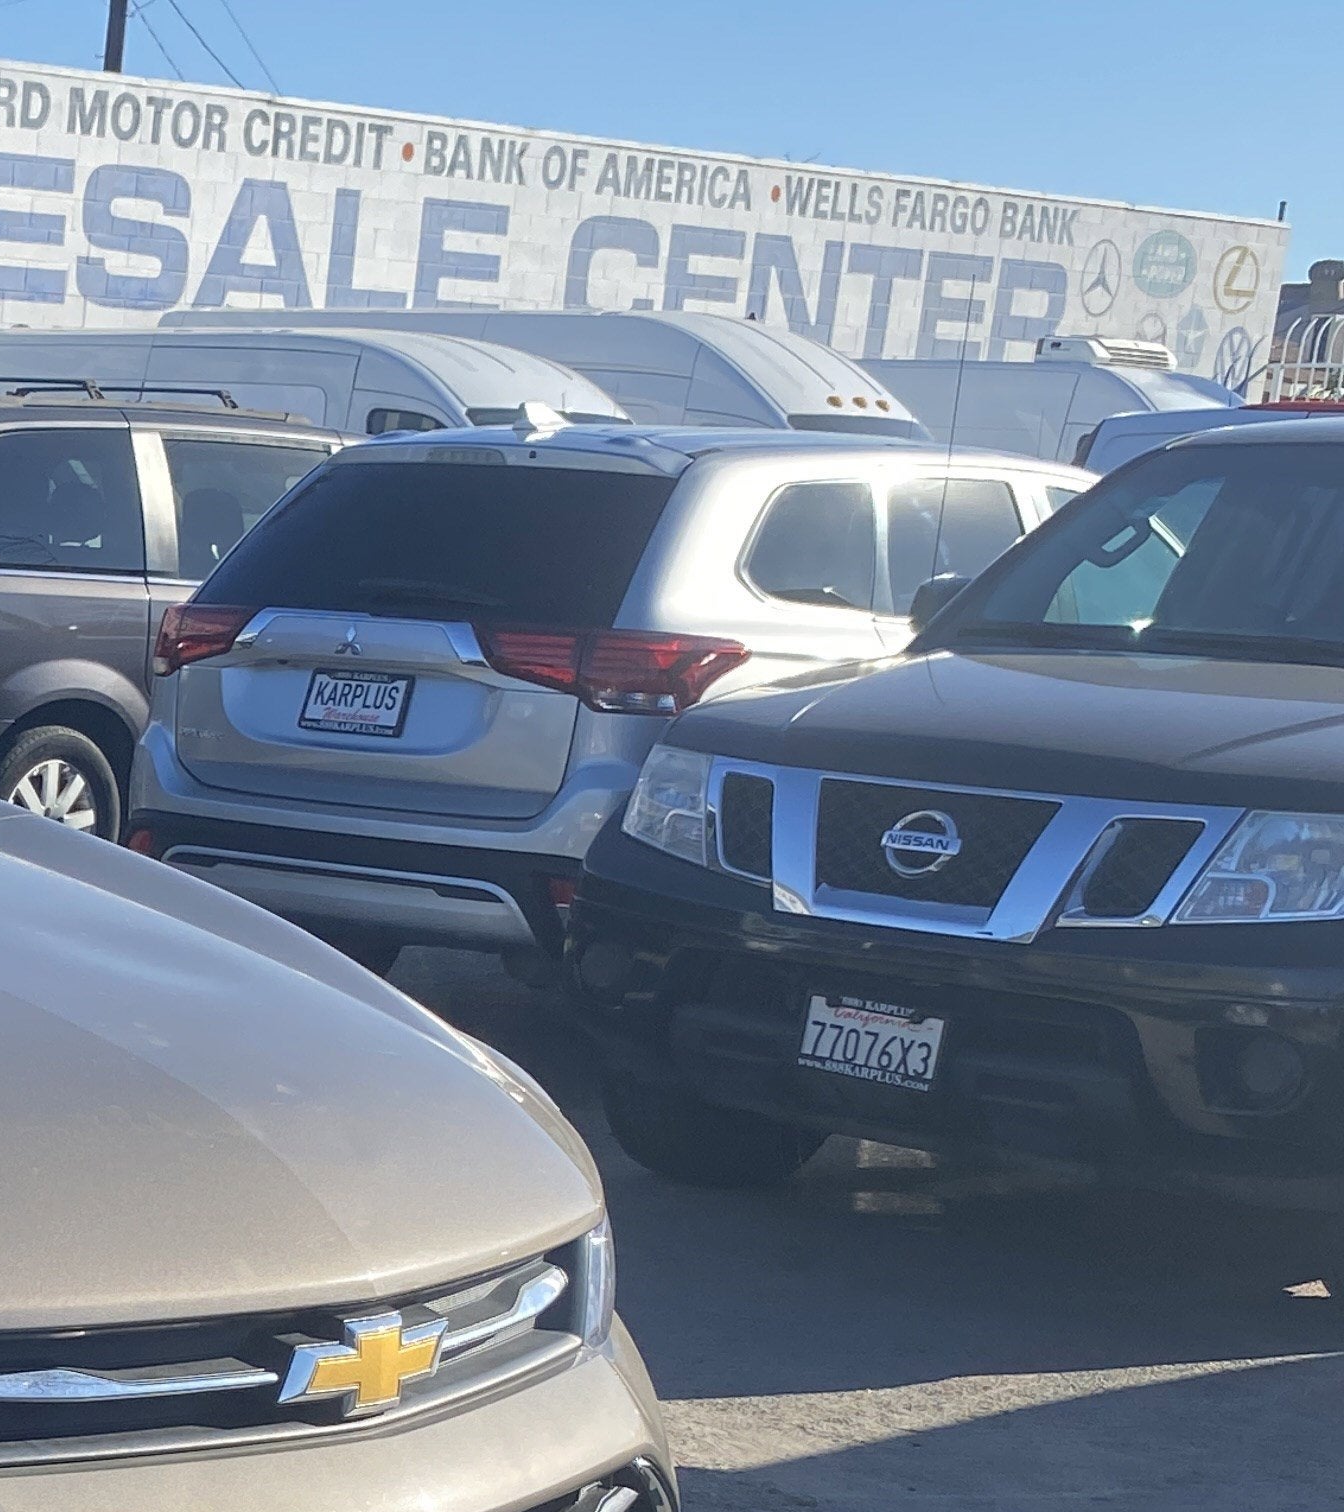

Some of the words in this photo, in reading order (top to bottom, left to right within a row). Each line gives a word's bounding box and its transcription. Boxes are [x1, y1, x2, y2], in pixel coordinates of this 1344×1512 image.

[65, 86, 230, 152] MOTOR
[243, 109, 394, 170] CREDIT
[423, 130, 530, 186] BANK
[541, 145, 589, 192] OF
[594, 152, 752, 212] AMERICA
[784, 175, 884, 225] WELLS
[891, 188, 990, 236] FARGO
[999, 201, 1081, 247] BANK
[563, 214, 1068, 361] CENTER
[313, 680, 400, 711] KARPLUS
[885, 832, 950, 851] NISSAN
[811, 1020, 932, 1077] 77076X3
